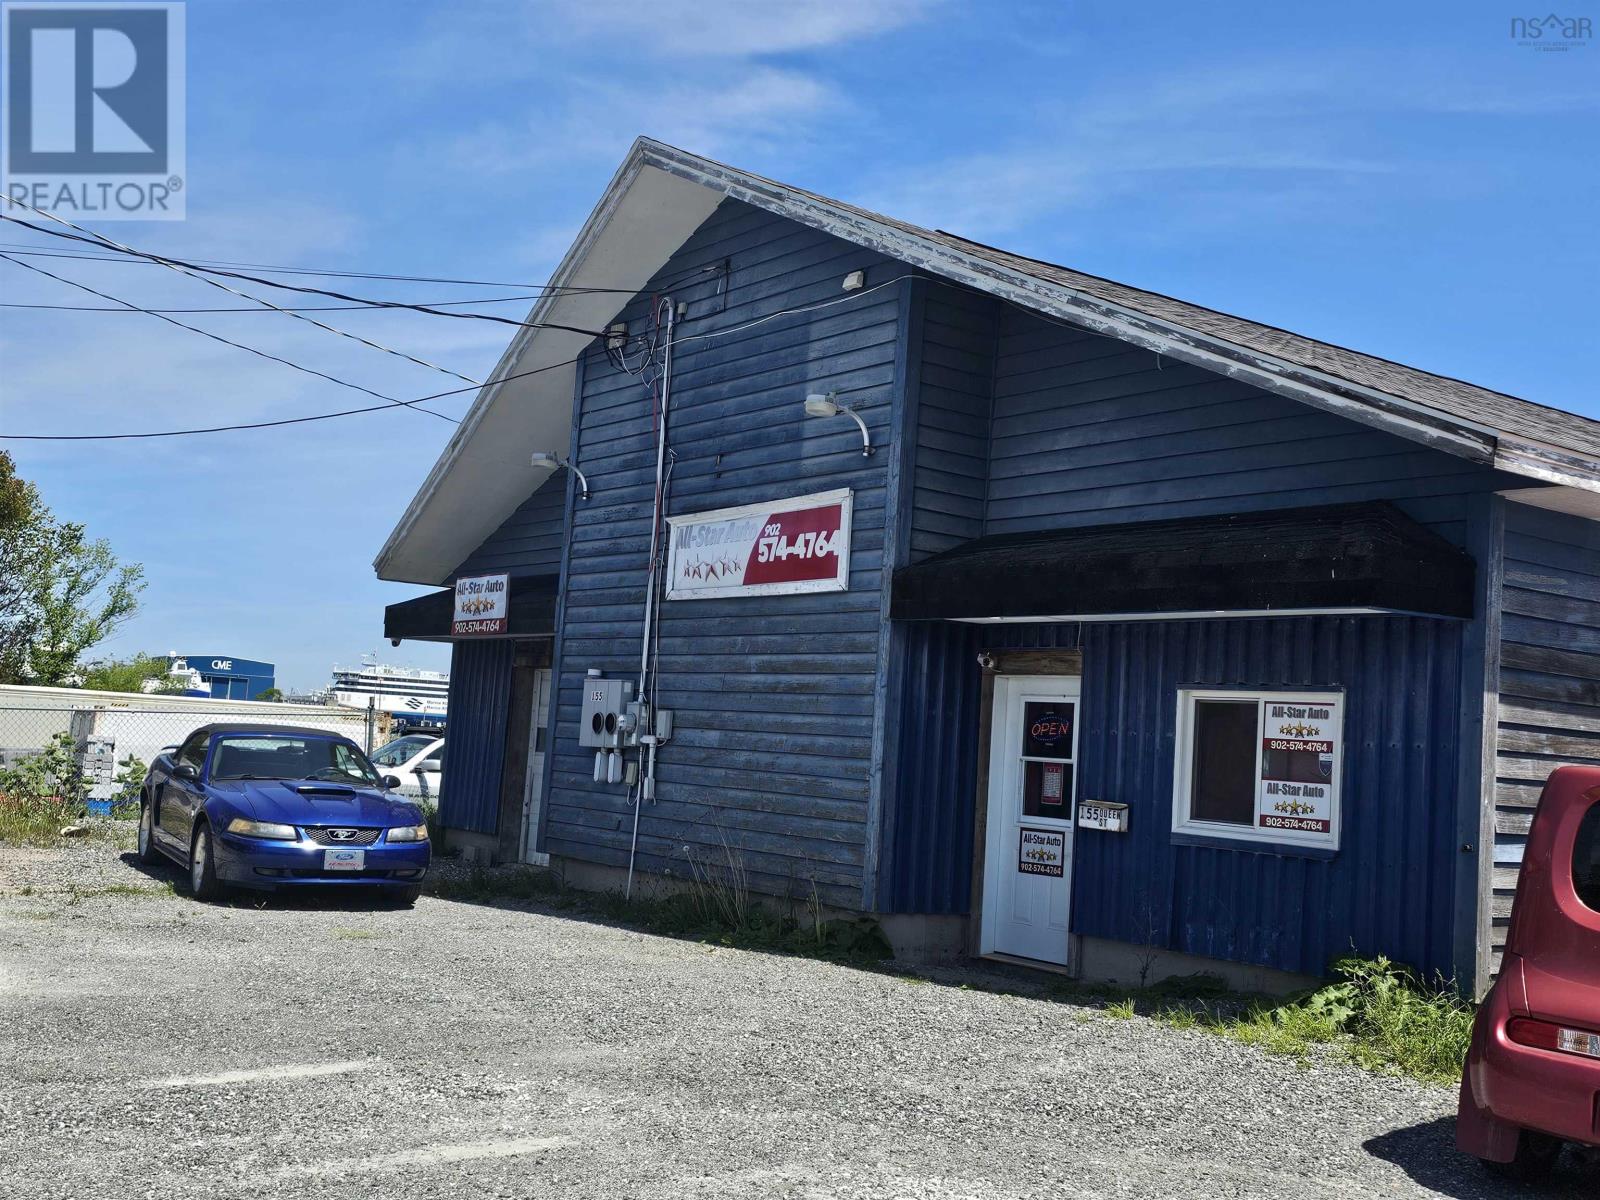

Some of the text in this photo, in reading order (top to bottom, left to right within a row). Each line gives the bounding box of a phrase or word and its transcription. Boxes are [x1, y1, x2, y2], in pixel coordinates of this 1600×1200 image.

[764, 523, 782, 537] 902
[758, 529, 841, 563] 574-4764
[457, 580, 504, 596] All-Star Auto
[455, 620, 500, 633] 902-574-4764
[211, 660, 232, 670] CME
[592, 691, 603, 701] 155
[1271, 706, 1330, 720] All-Star Auto
[1032, 722, 1069, 736] OPEN
[1270, 740, 1328, 752] 902-574-4764
[1266, 782, 1325, 798] All-Star Auto
[1080, 807, 1121, 820] 155 QUEEN
[1099, 818, 1108, 828] ST
[1265, 817, 1323, 831] 902-574-4764
[1023, 833, 1062, 847] All-Star Auto
[1020, 863, 1062, 875] 902-574-4764
